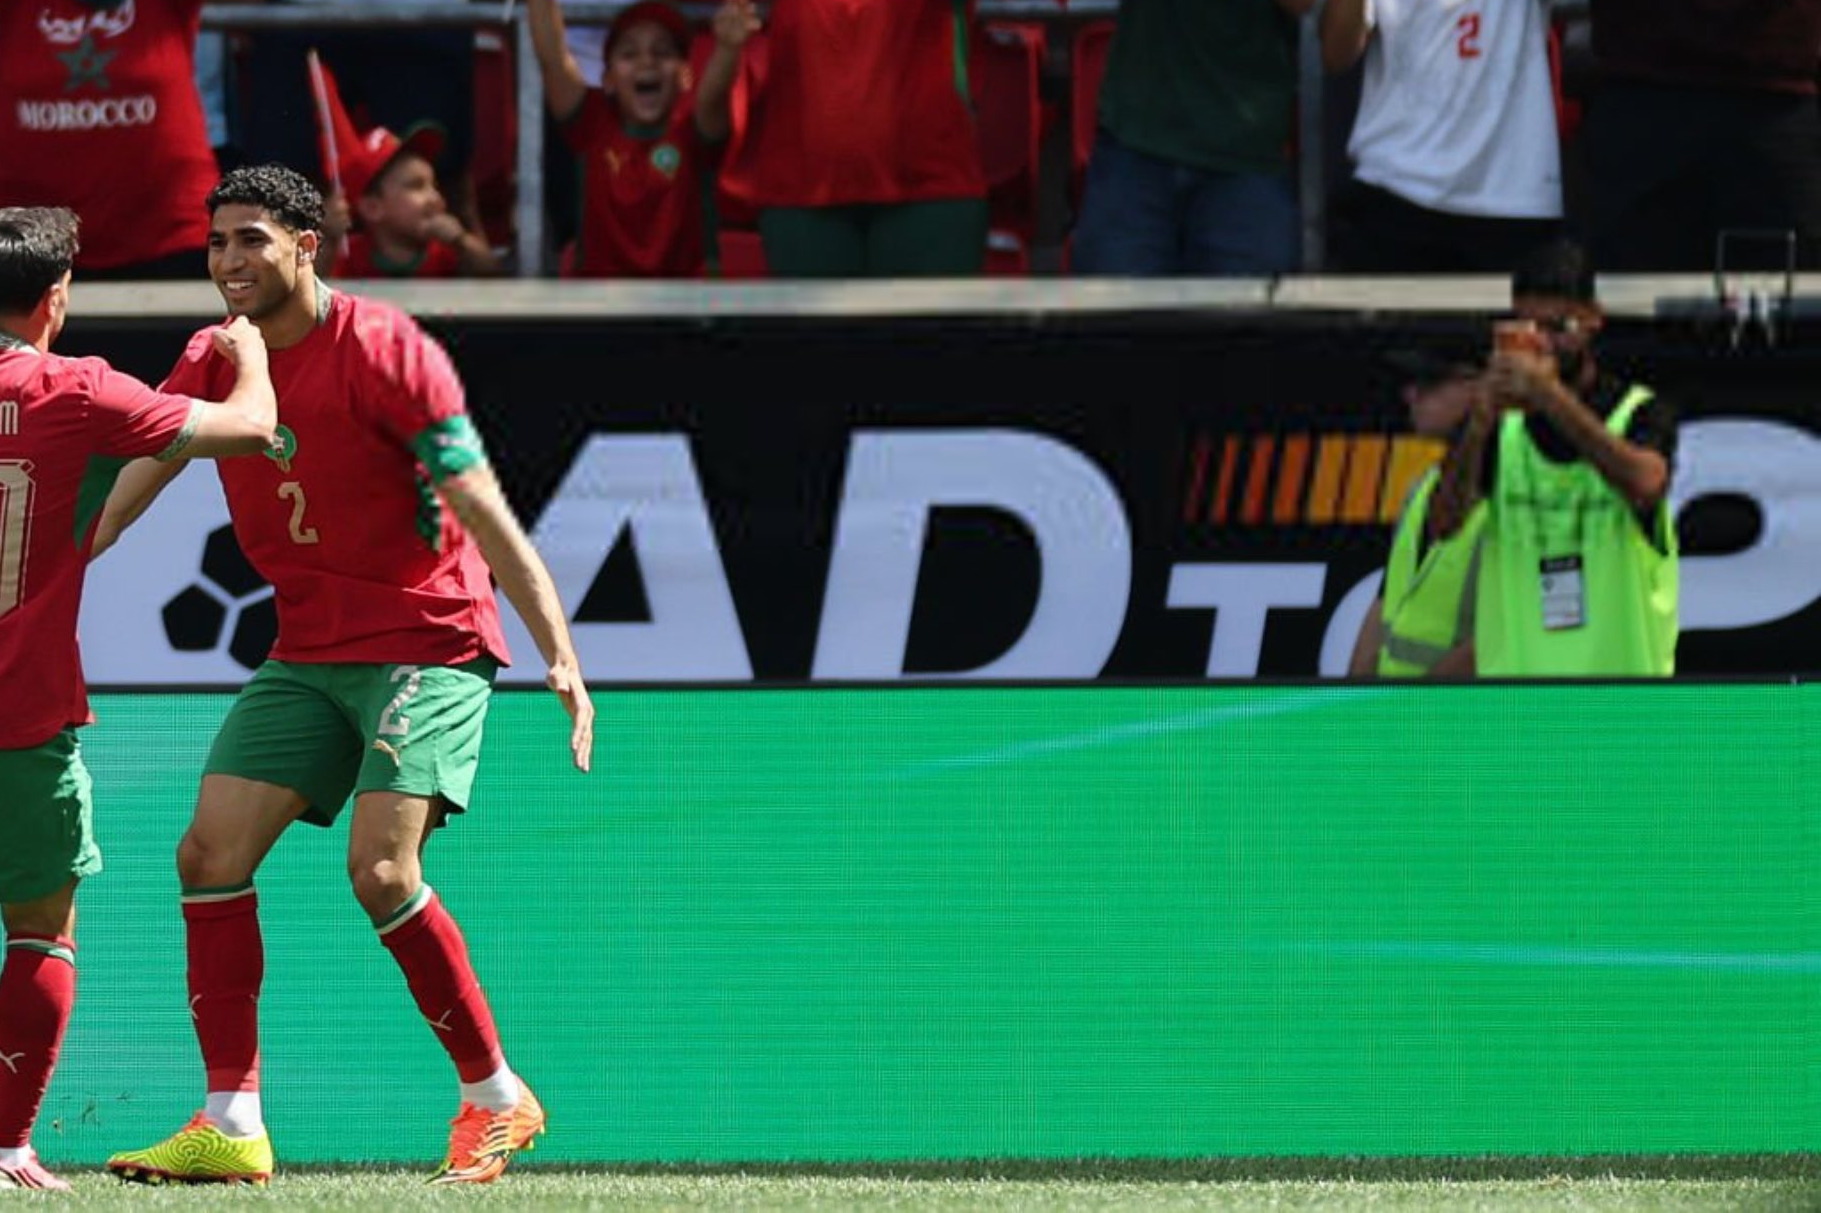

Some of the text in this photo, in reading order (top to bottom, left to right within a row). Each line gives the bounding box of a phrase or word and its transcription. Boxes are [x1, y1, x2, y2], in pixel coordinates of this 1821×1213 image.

[1456, 11, 1482, 60] 2
[16, 94, 158, 131] MOROCCO
[277, 481, 320, 544] 2
[377, 664, 422, 737] 2
